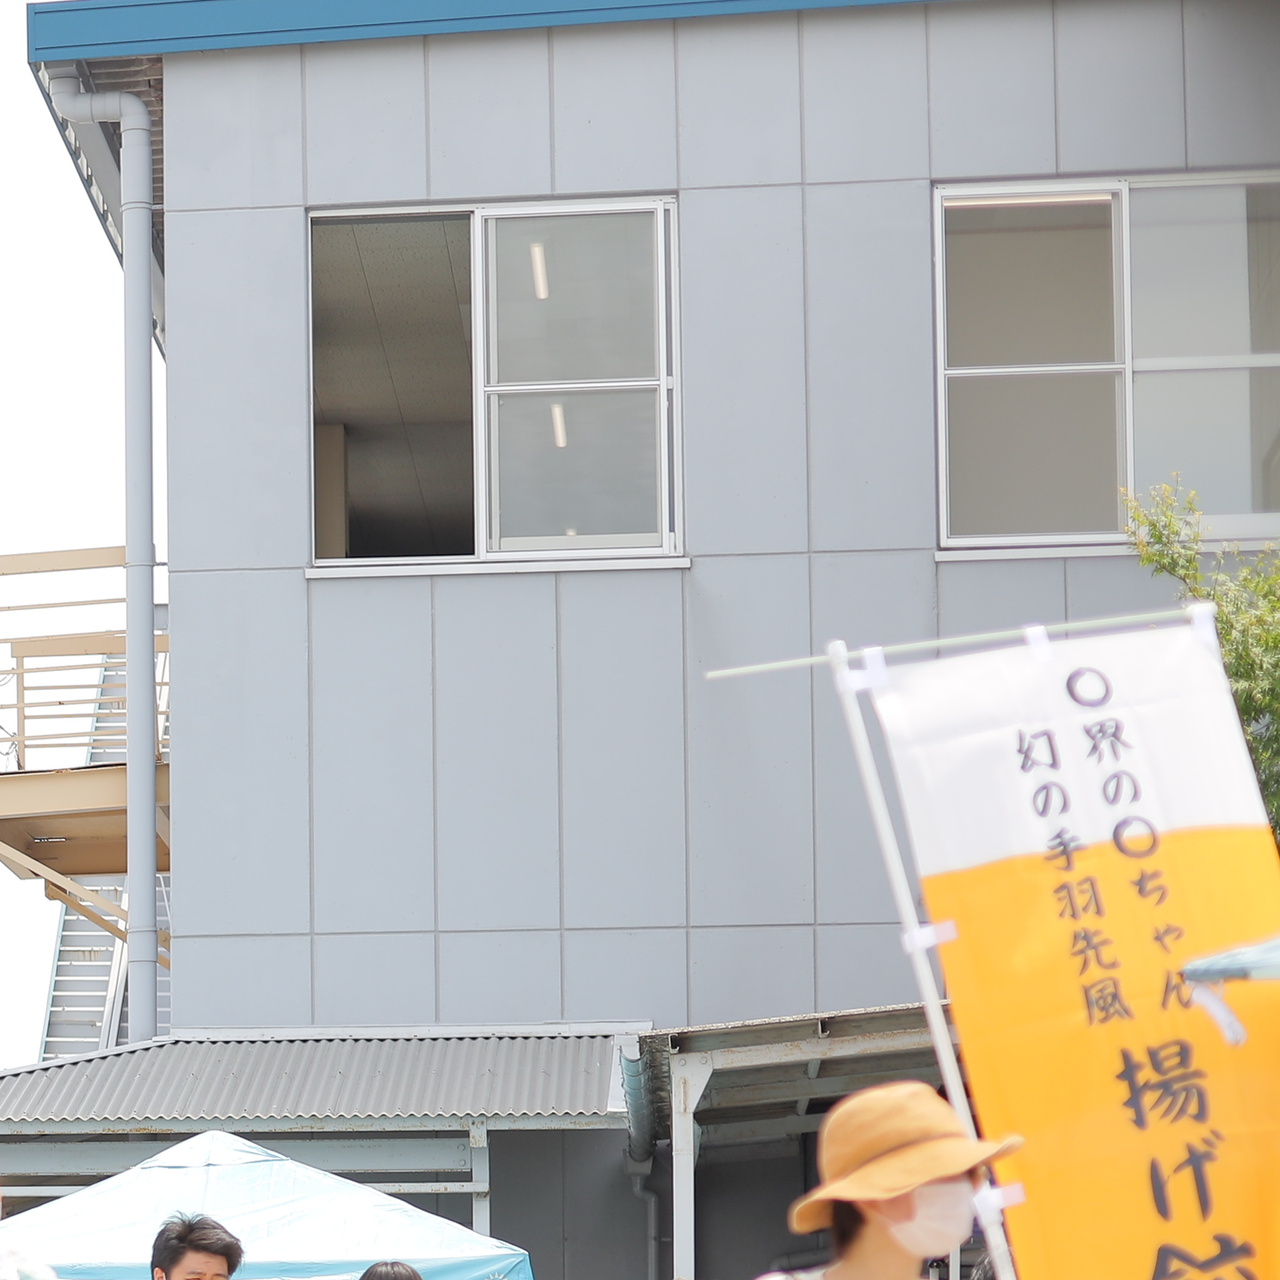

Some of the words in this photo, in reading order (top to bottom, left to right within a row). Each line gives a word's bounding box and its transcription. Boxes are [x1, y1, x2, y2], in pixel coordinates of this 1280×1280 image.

[1016, 728, 1135, 1027] 幻の手羽先風
